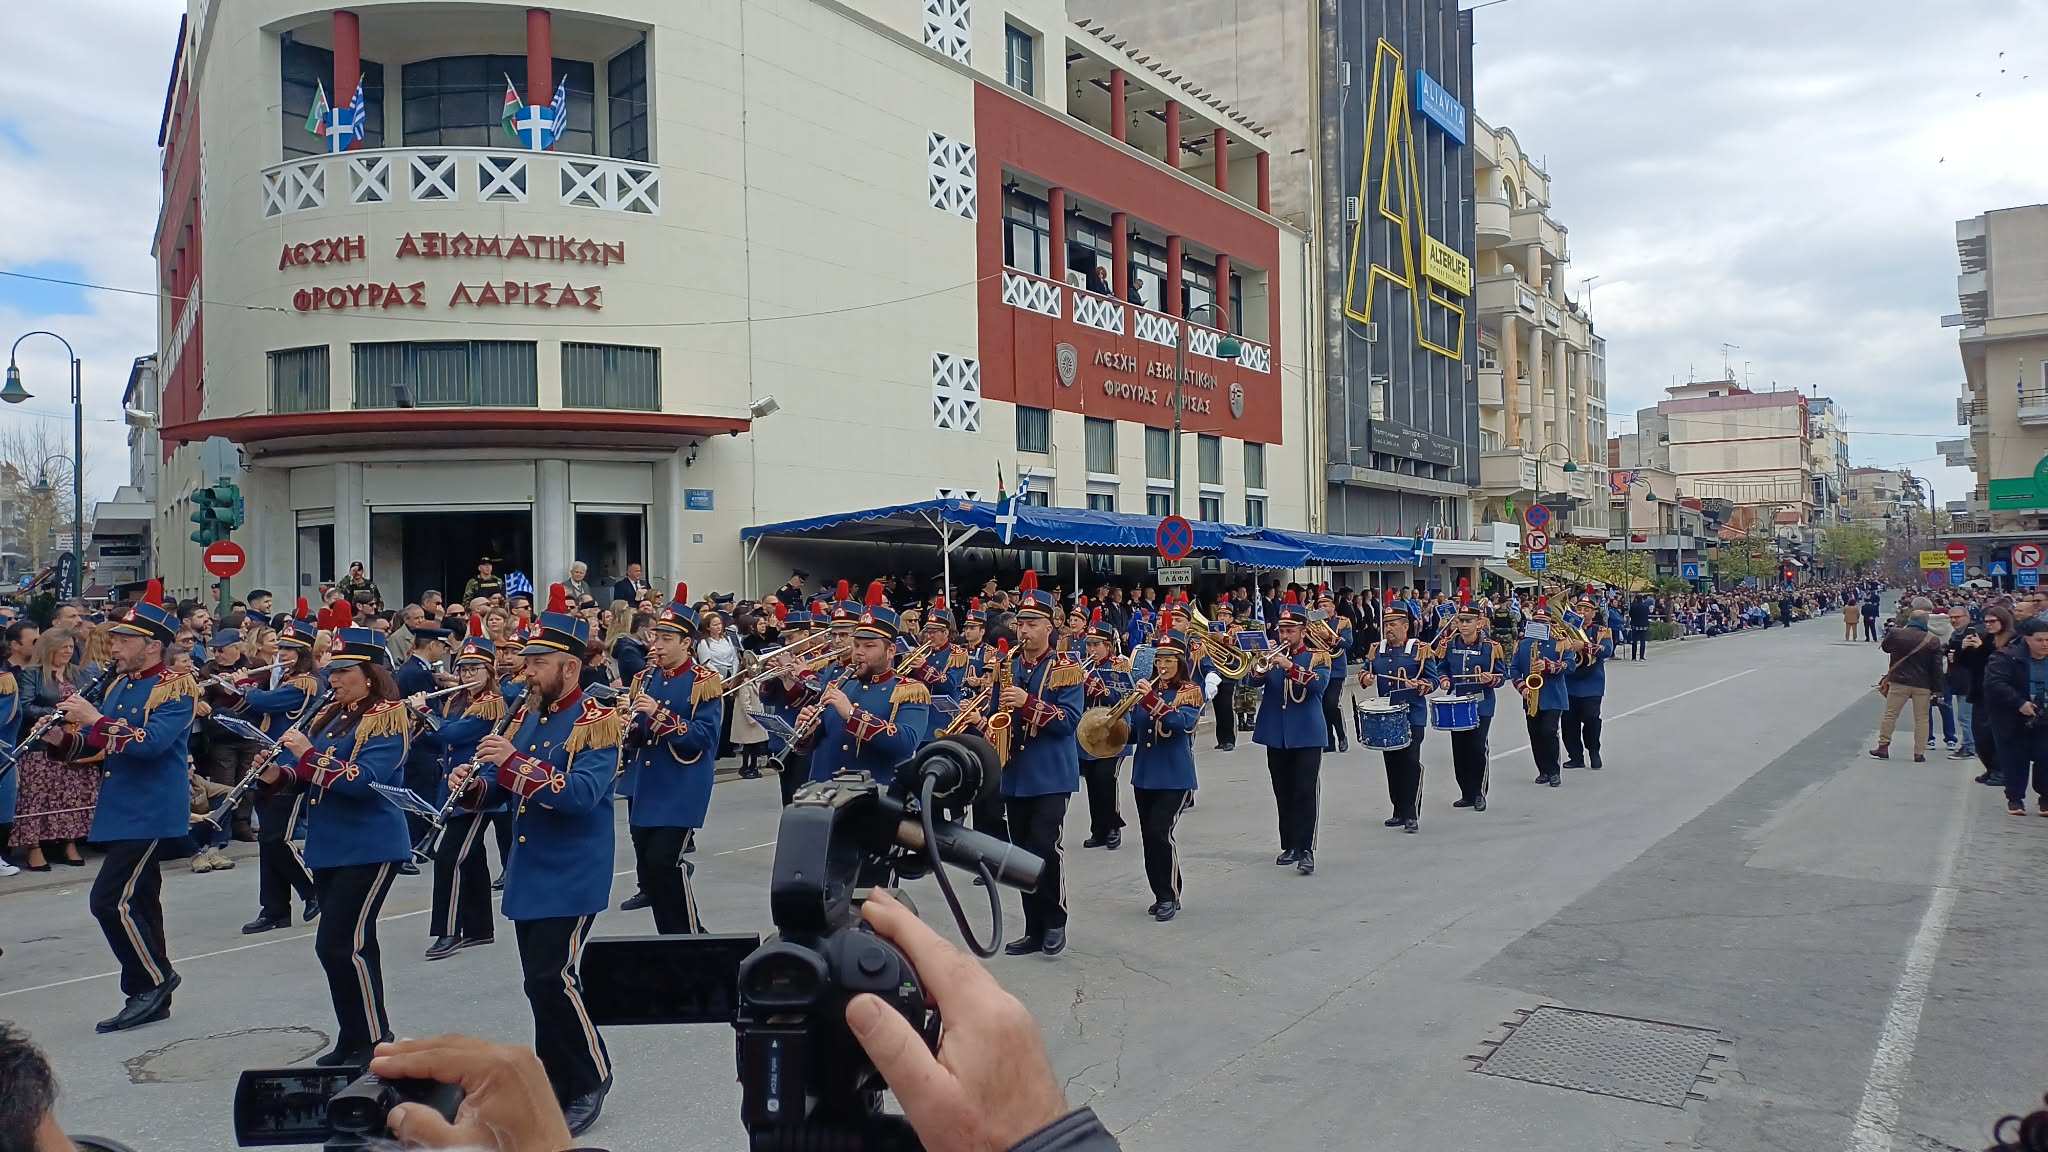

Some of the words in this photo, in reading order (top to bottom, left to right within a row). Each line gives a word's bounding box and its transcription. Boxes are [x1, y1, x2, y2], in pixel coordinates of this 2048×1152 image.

[278, 235, 365, 271] ΛΕΣΧΗ
[395, 231, 625, 267] ΑΞΙΩΜΑΤΙΚΩΝ
[1430, 243, 1467, 279] ALTERLIFE
[293, 280, 427, 312] ΦΡΟΥΡΑΣ
[448, 281, 603, 311] ΛΑΡΙΣΑΣ
[1093, 347, 1137, 374] ΛΕΣΧΗ
[1103, 379, 1158, 406] ΦΡΟΥΡΑΣ
[1165, 391, 1211, 415] ΛΡΙΣΑΣ
